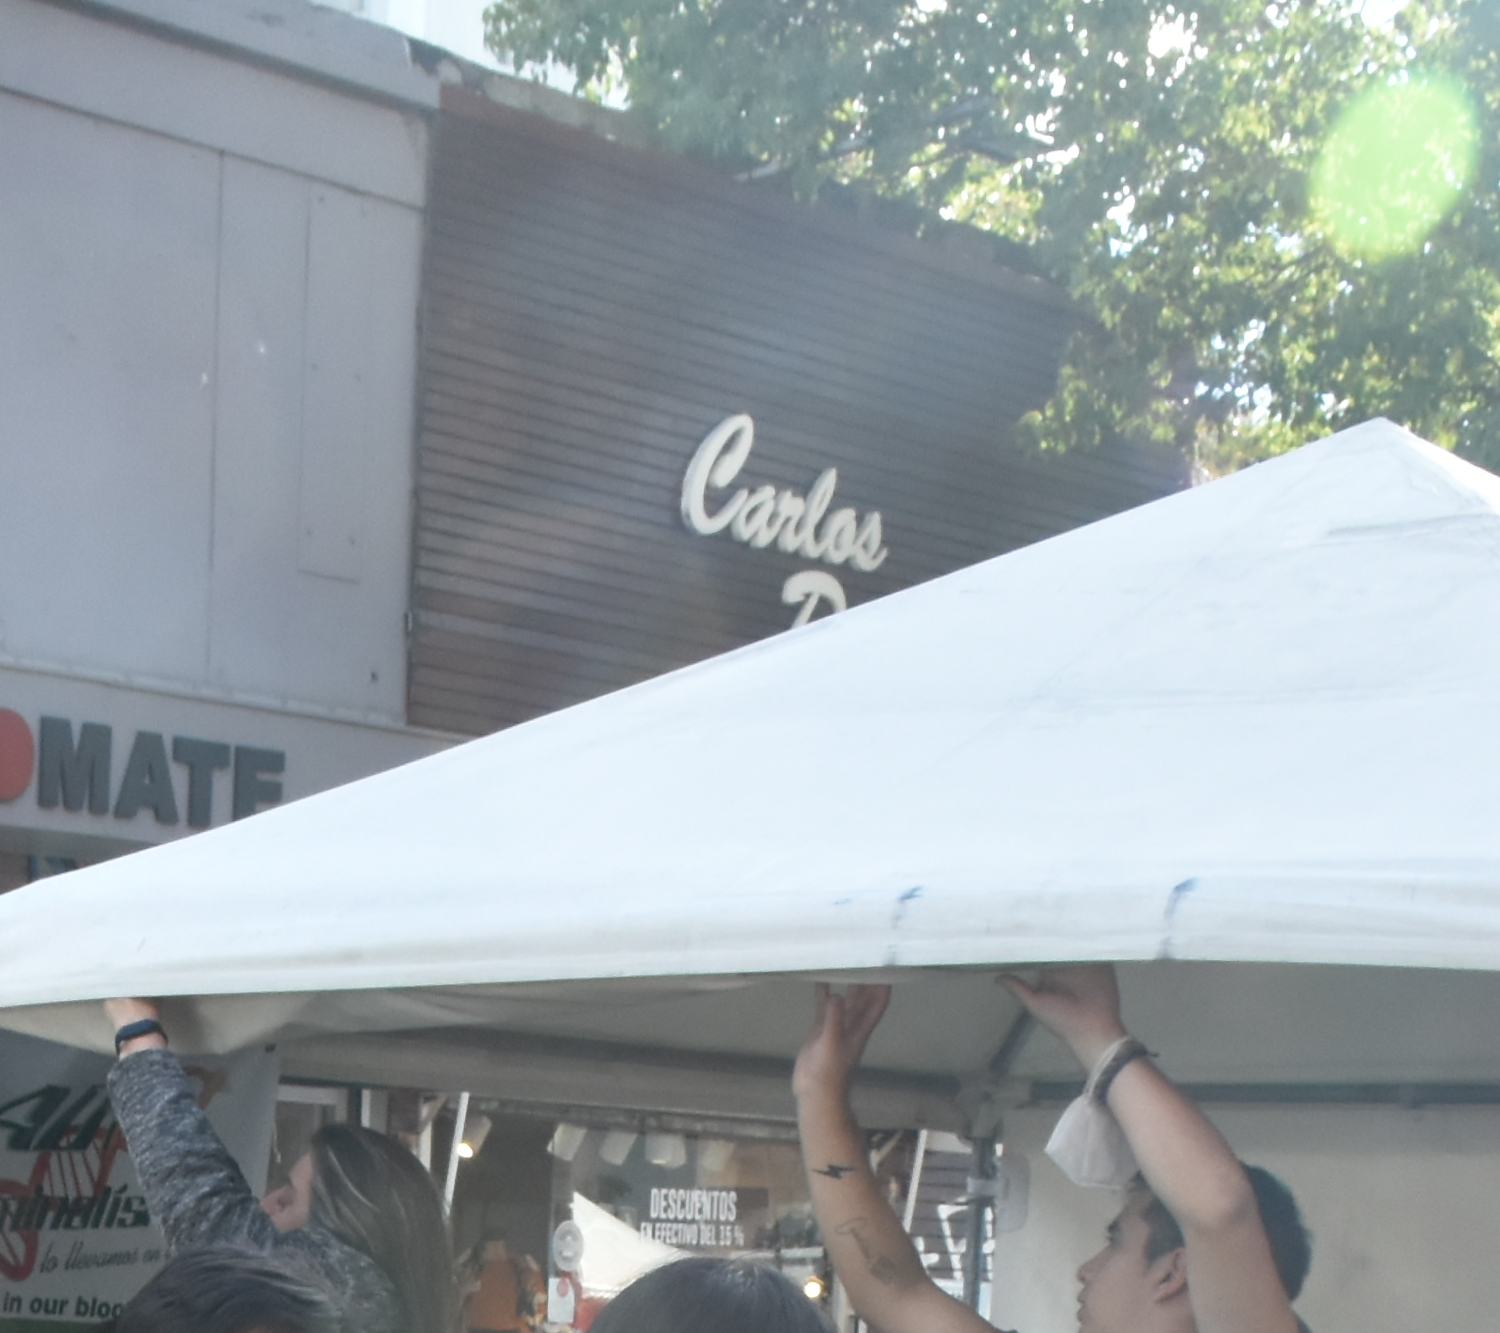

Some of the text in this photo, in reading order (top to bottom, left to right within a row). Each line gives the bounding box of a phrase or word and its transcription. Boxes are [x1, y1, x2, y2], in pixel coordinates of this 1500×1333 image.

[681, 413, 888, 571] Carlos
[650, 1188, 738, 1222] DESCUENTOS
[655, 1222, 699, 1245] EFECTIVO
[701, 1224, 716, 1245] DEL
[3, 1292, 22, 1313] in
[29, 1299, 69, 1316] our
